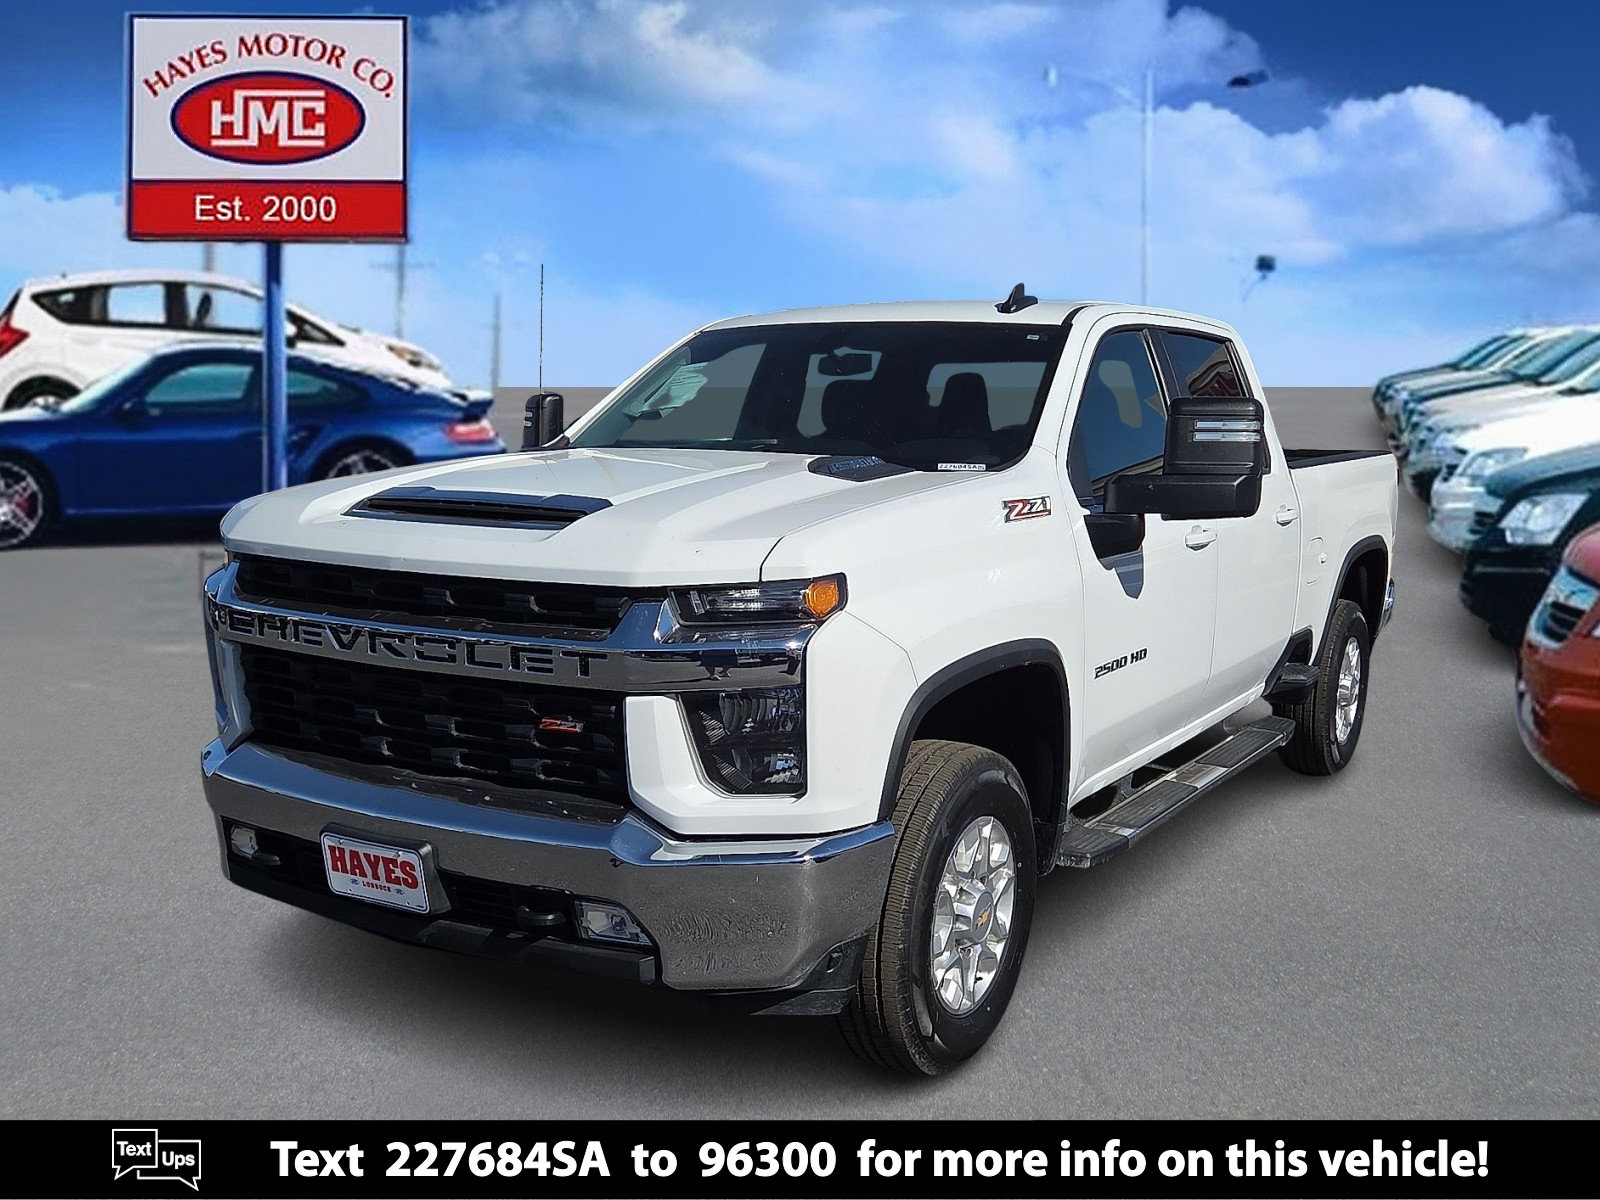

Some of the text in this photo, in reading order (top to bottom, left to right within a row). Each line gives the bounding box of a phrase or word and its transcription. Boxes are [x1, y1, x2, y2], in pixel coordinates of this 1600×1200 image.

[142, 33, 394, 98] HAYES MOTOR CO.
[210, 89, 326, 147] HMC
[195, 194, 337, 222] Est. 2000
[228, 609, 608, 677] CHEVROLET
[1094, 648, 1148, 680] 2500 HD
[328, 845, 419, 889] HAYES
